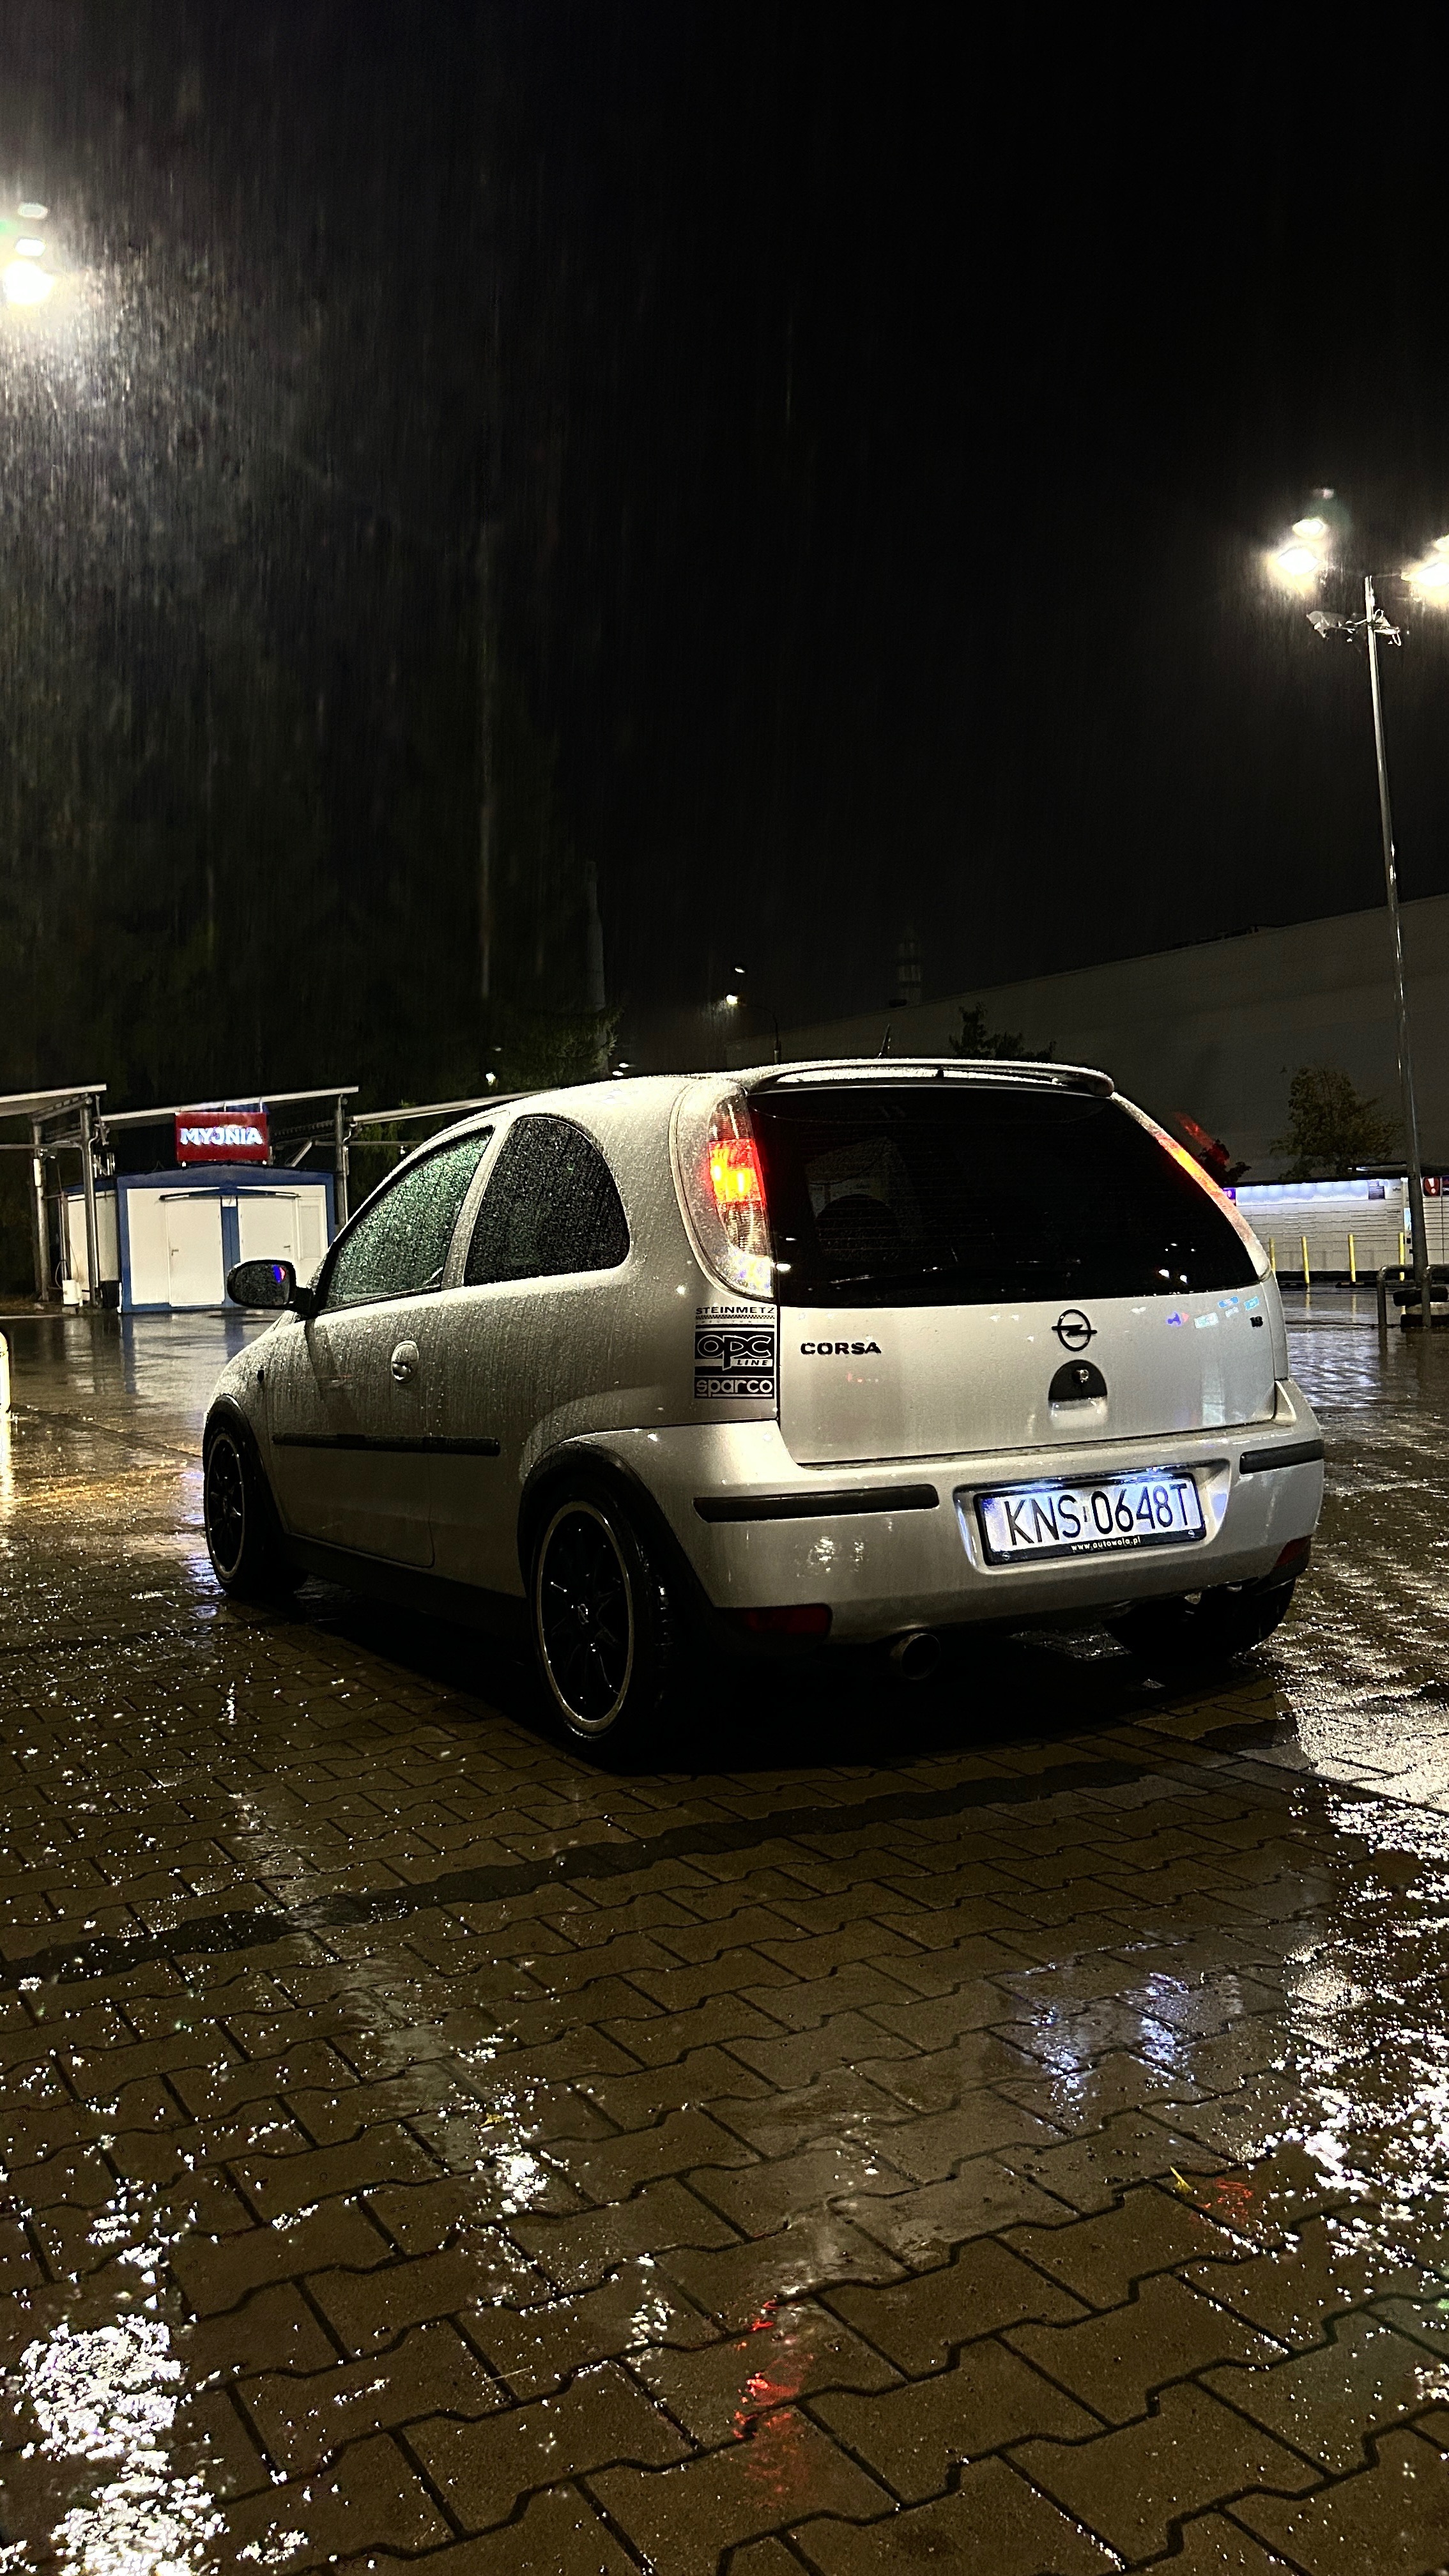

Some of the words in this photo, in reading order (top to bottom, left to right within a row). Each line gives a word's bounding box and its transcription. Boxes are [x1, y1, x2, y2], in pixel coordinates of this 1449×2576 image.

[180, 1127, 263, 1145] MYJNIA
[696, 1307, 775, 1315] STEINMETZ
[801, 1342, 882, 1355] CORSA
[696, 1379, 773, 1397] sparco
[1004, 1494, 1081, 1546] KNS
[1091, 1483, 1188, 1535] 0648T
